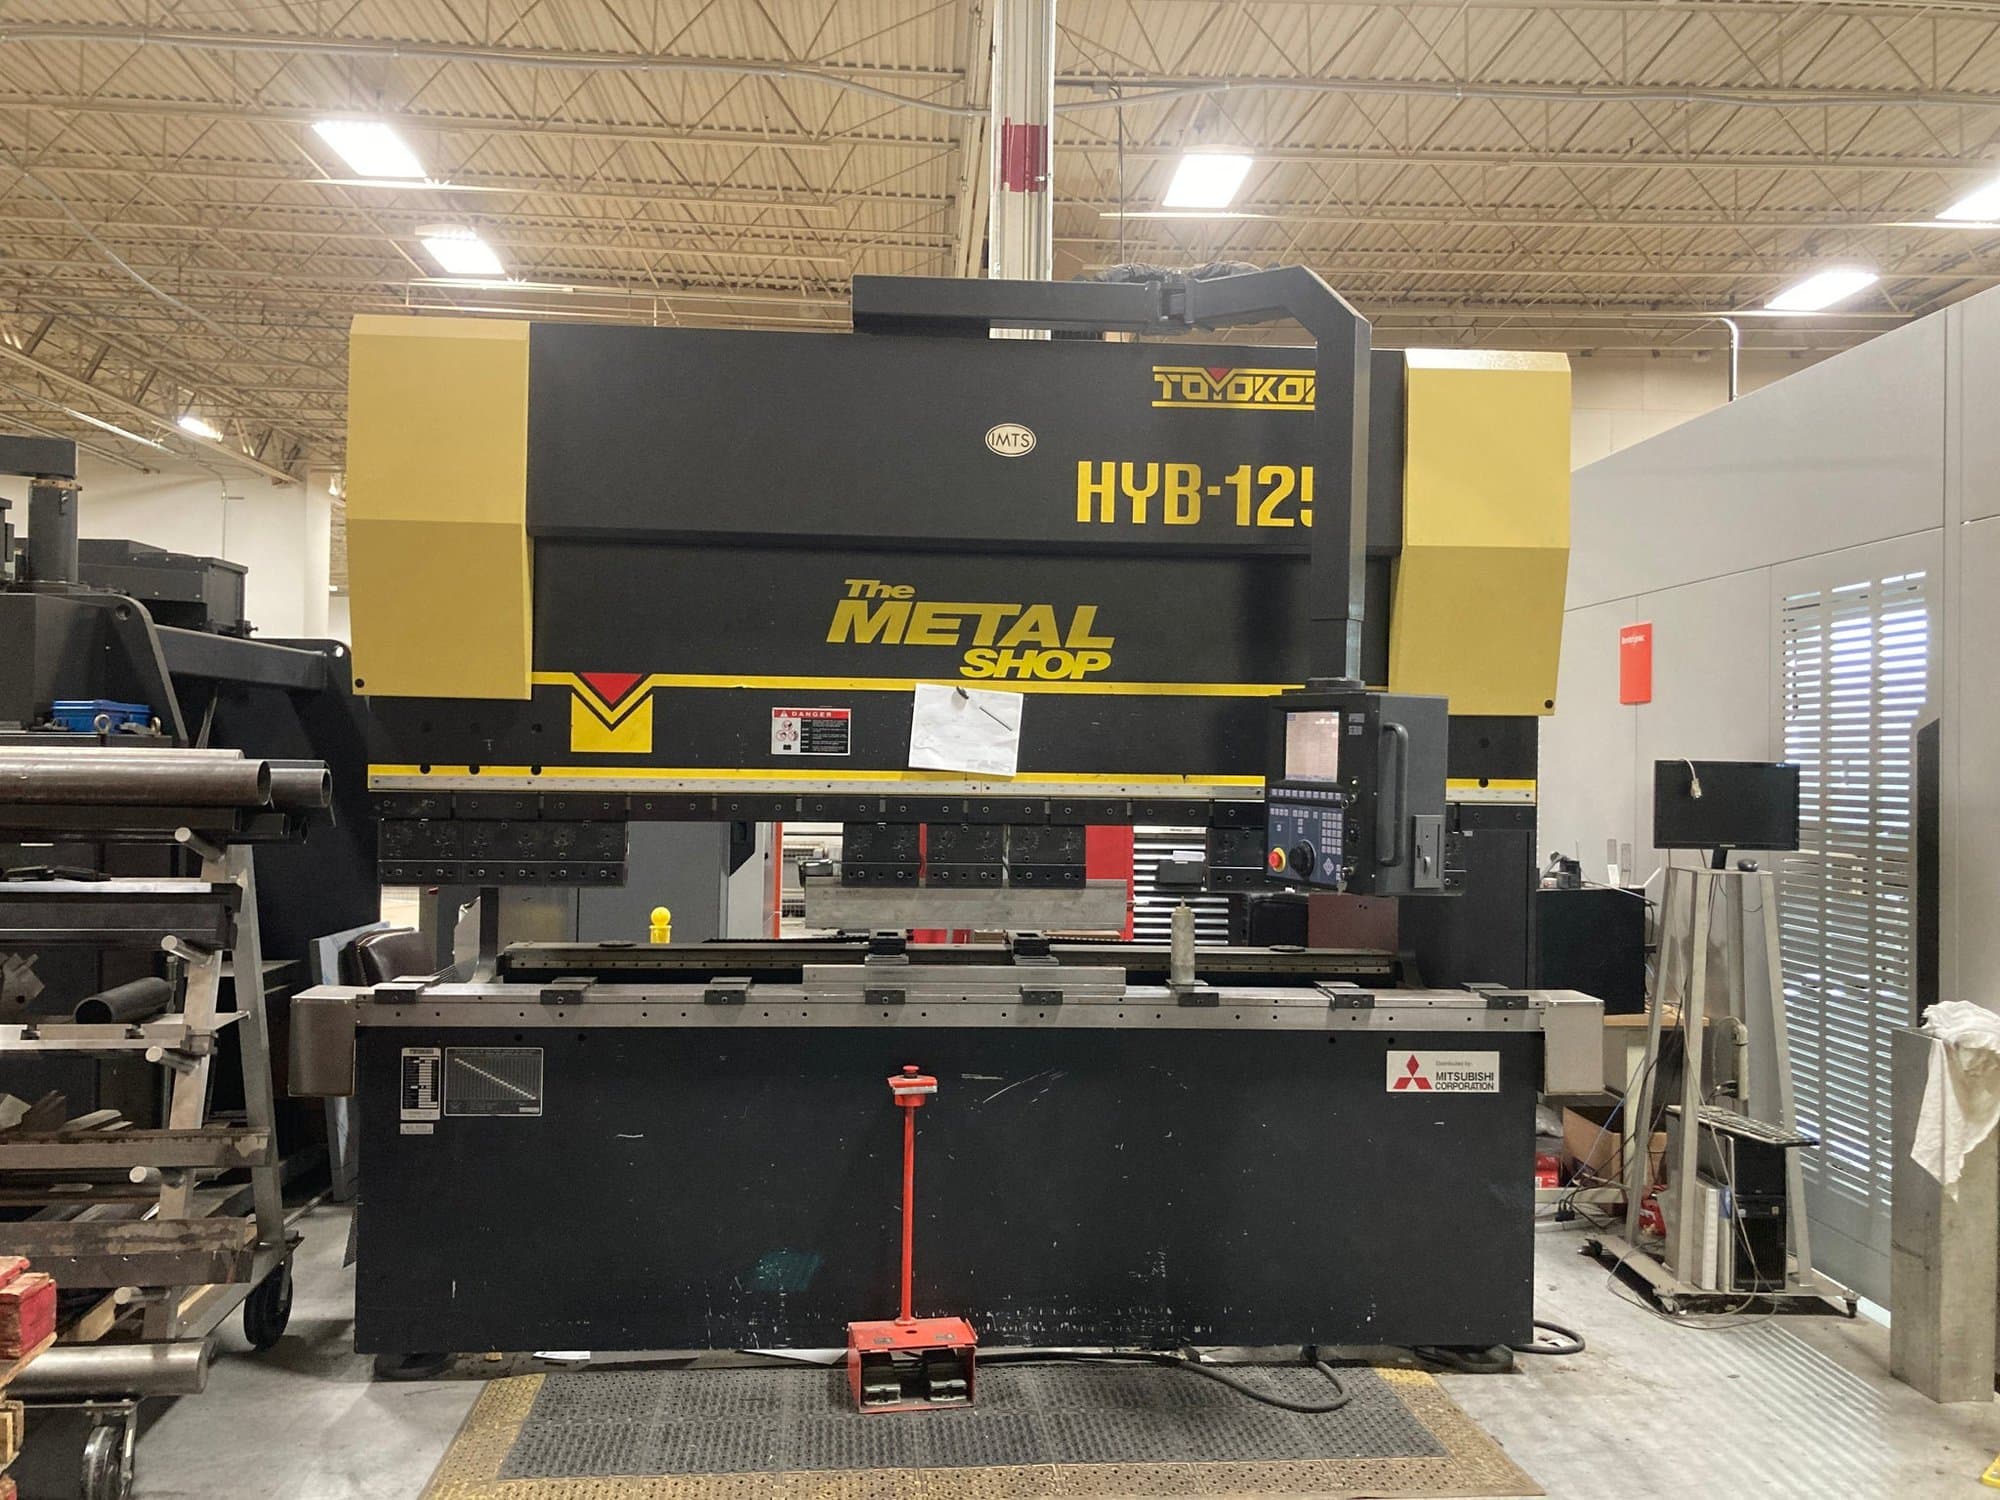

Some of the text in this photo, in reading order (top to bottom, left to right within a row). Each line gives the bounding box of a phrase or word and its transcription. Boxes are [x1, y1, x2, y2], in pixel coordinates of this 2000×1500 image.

[991, 432, 1030, 448] IMTS
[844, 578, 916, 600] The
[826, 599, 1116, 649] METAL
[960, 647, 1113, 680] SHOP
[1435, 1082, 1494, 1090] CORPORATION
[1436, 1072, 1494, 1081] MITSUBISHI
